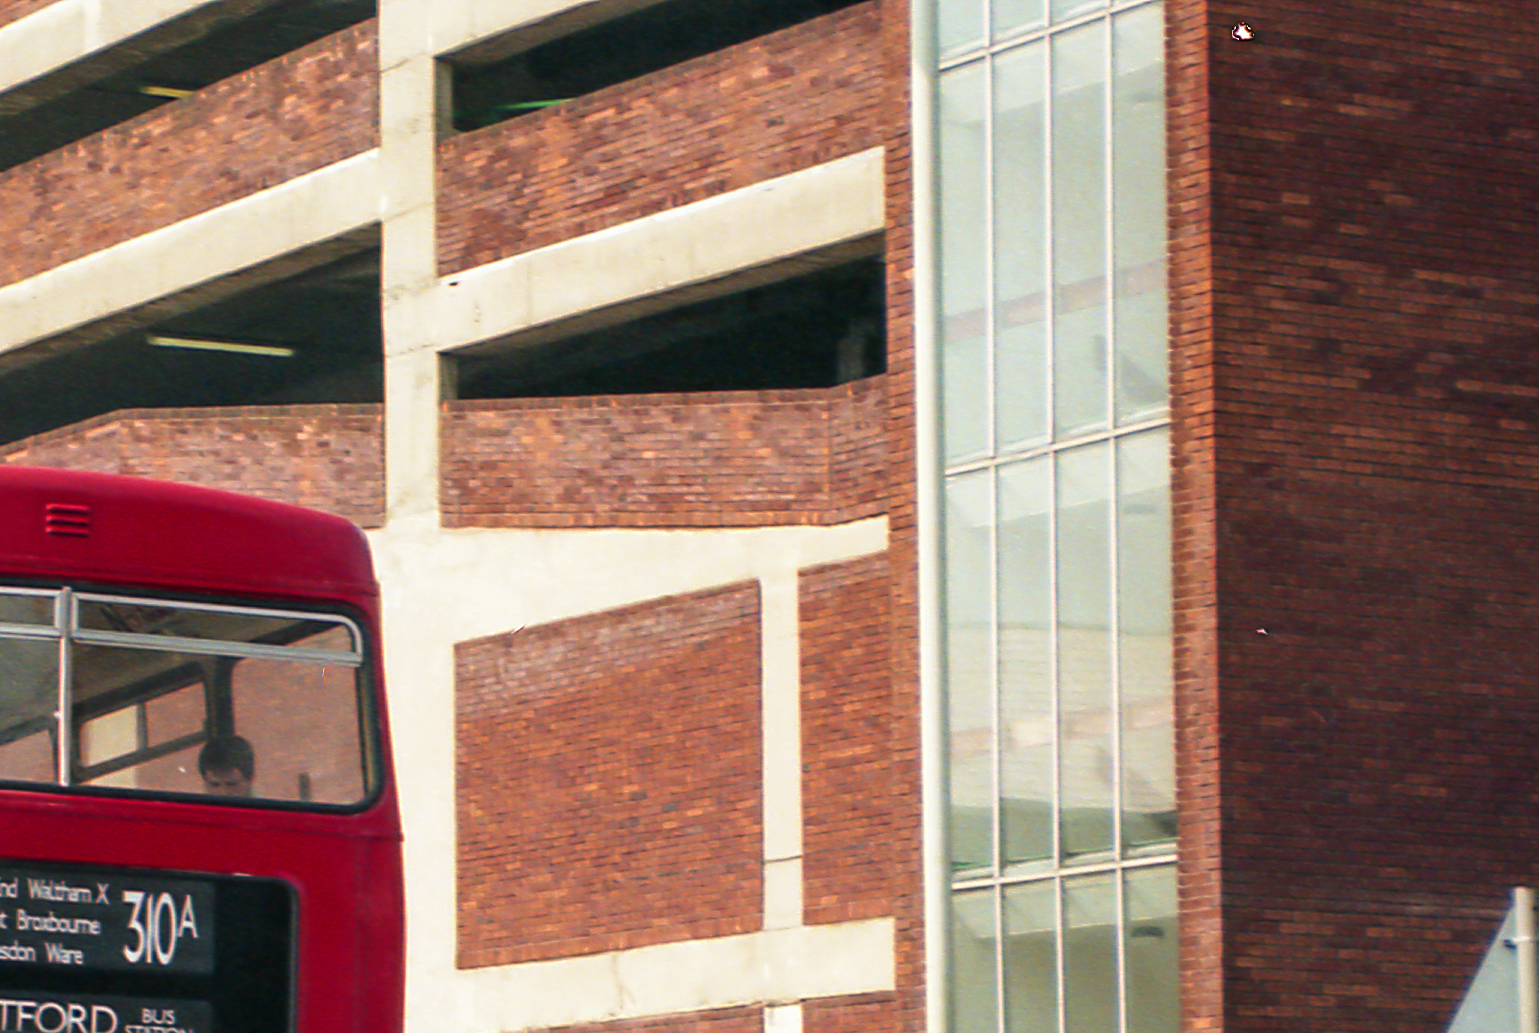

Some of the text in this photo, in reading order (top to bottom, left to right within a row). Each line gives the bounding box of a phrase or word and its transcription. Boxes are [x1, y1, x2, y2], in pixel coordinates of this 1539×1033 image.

[28, 877, 93, 903] Waltham
[96, 882, 110, 905] X
[16, 908, 102, 934] Broxbourne
[45, 941, 85, 965] Ware
[141, 1008, 176, 1025] BUS
